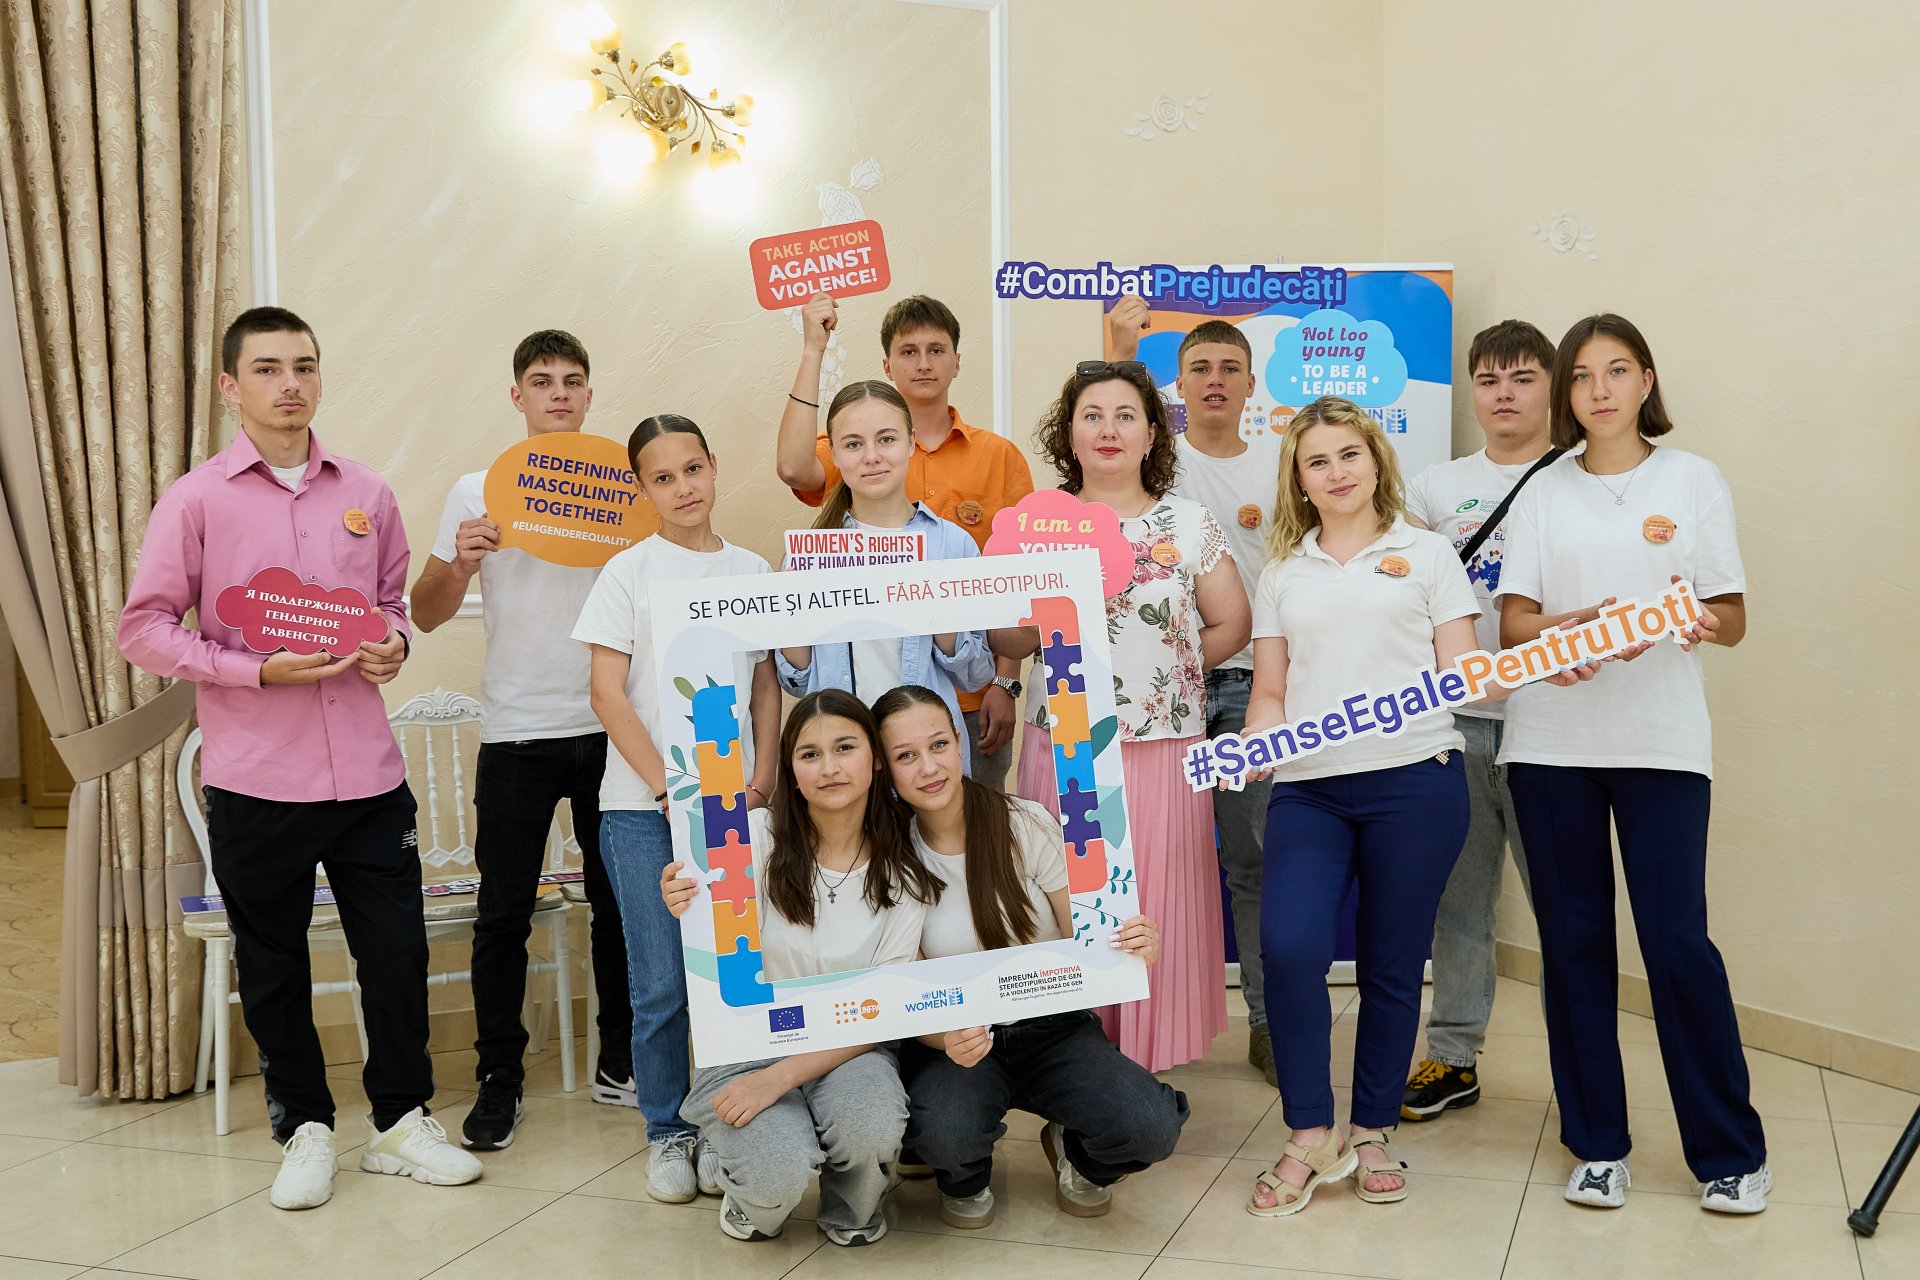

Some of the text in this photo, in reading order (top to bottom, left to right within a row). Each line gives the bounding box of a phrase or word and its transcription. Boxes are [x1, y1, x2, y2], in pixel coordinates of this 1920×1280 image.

[762, 229, 870, 262] TAKE ACTION
[768, 246, 872, 283] AGAINST
[770, 267, 878, 301] VIOLENCE!
[999, 265, 1343, 309] #CombatPrejudecăți
[1302, 326, 1368, 342] Not too
[1302, 345, 1367, 362] young
[1302, 364, 1367, 379] TO BE A
[1302, 380, 1367, 396] LEADER
[526, 452, 635, 485] REDEFINING
[517, 473, 638, 507] MASCULINITY
[524, 496, 623, 526] TOGETHER!
[1017, 512, 1095, 533] I am a
[512, 520, 632, 548] #EU4GENDEREQUALITY
[789, 532, 864, 554] WOMEN'S
[868, 535, 914, 553] RIGHTS
[244, 589, 365, 617] Я ПОДДЕРЖИВАЮ
[688, 572, 1069, 620] SE POATE ȘI ALTFEL. FĂRĂ STEREOTIPURI.
[265, 609, 341, 630] ГЕНДЕРНОЕ
[261, 626, 338, 646] РАВЕНСТВО
[1188, 585, 1697, 786] #ȘanseEgalePentruToți
[997, 965, 1082, 984] ÎMPREUNĂ ÎMPOTRIVA
[998, 972, 1082, 991] STEREOTIPURILOR DE GEN
[905, 989, 948, 1013] UN WOMEN
